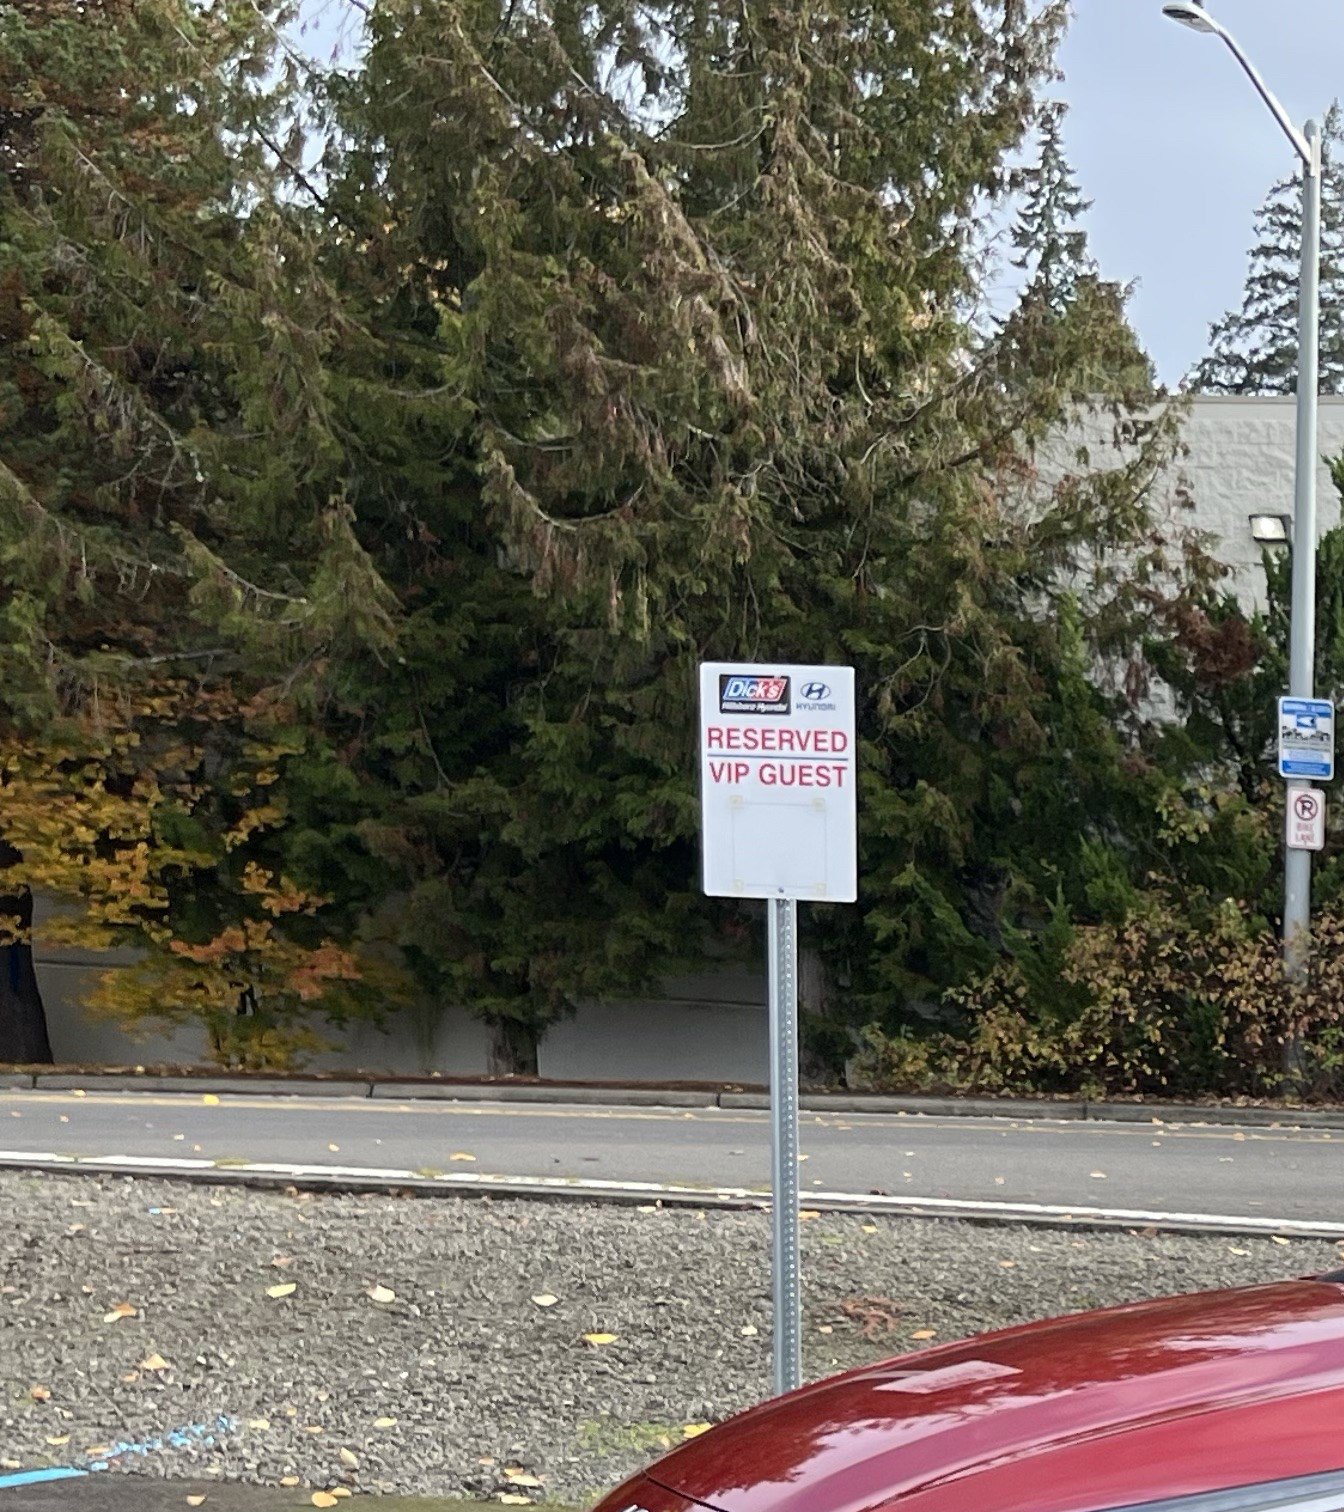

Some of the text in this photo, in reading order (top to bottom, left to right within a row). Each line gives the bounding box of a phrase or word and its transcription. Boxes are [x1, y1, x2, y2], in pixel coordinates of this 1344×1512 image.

[707, 727, 848, 752] RESERVED
[709, 762, 848, 788] VIP GUEST
